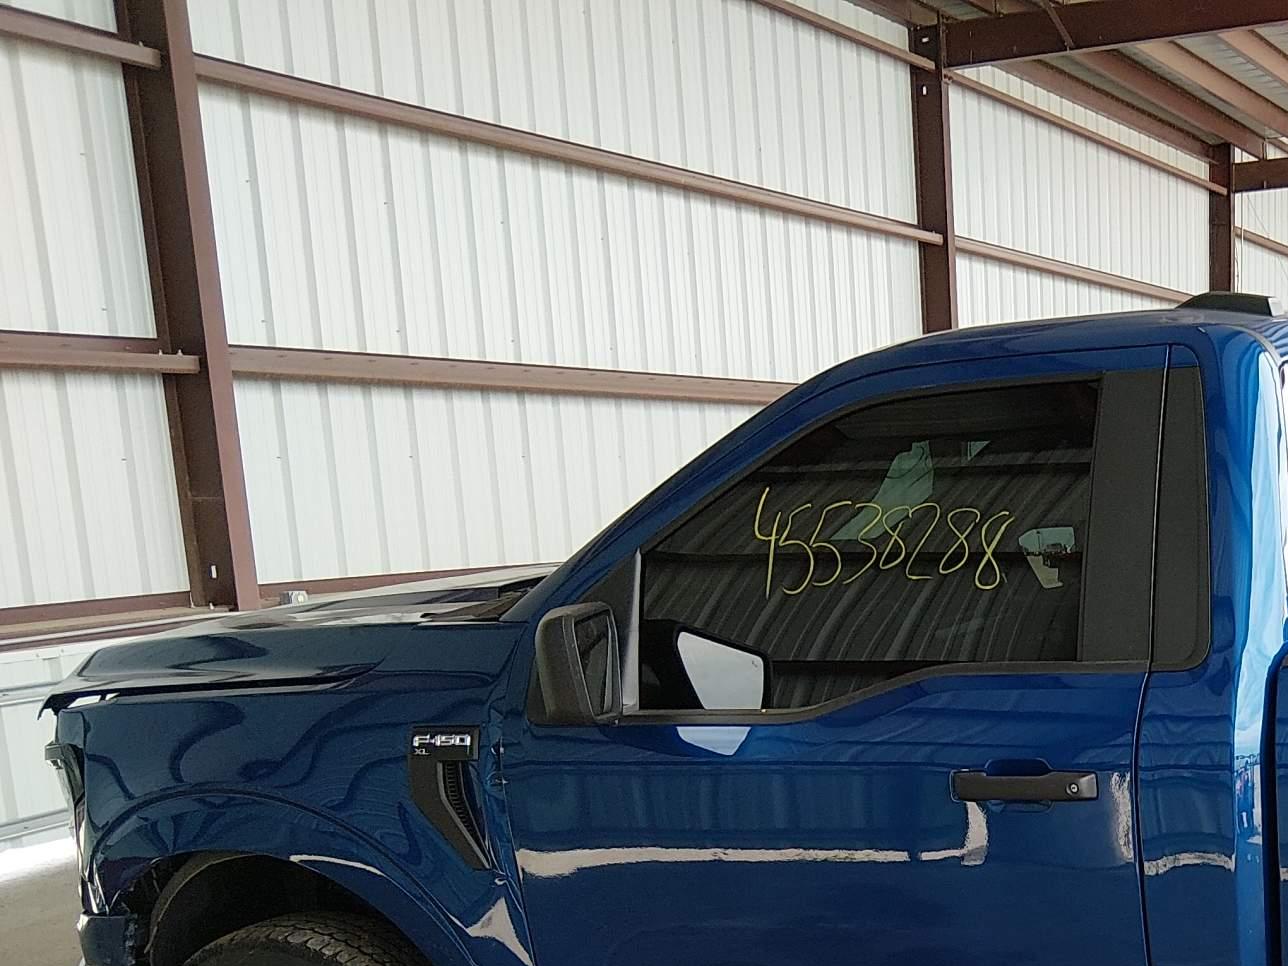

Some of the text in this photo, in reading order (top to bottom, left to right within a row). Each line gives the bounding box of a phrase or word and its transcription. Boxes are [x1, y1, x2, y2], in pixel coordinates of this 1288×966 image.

[754, 487, 1016, 600] 45538288
[412, 733, 472, 747] F-150
[413, 748, 430, 756] XL
